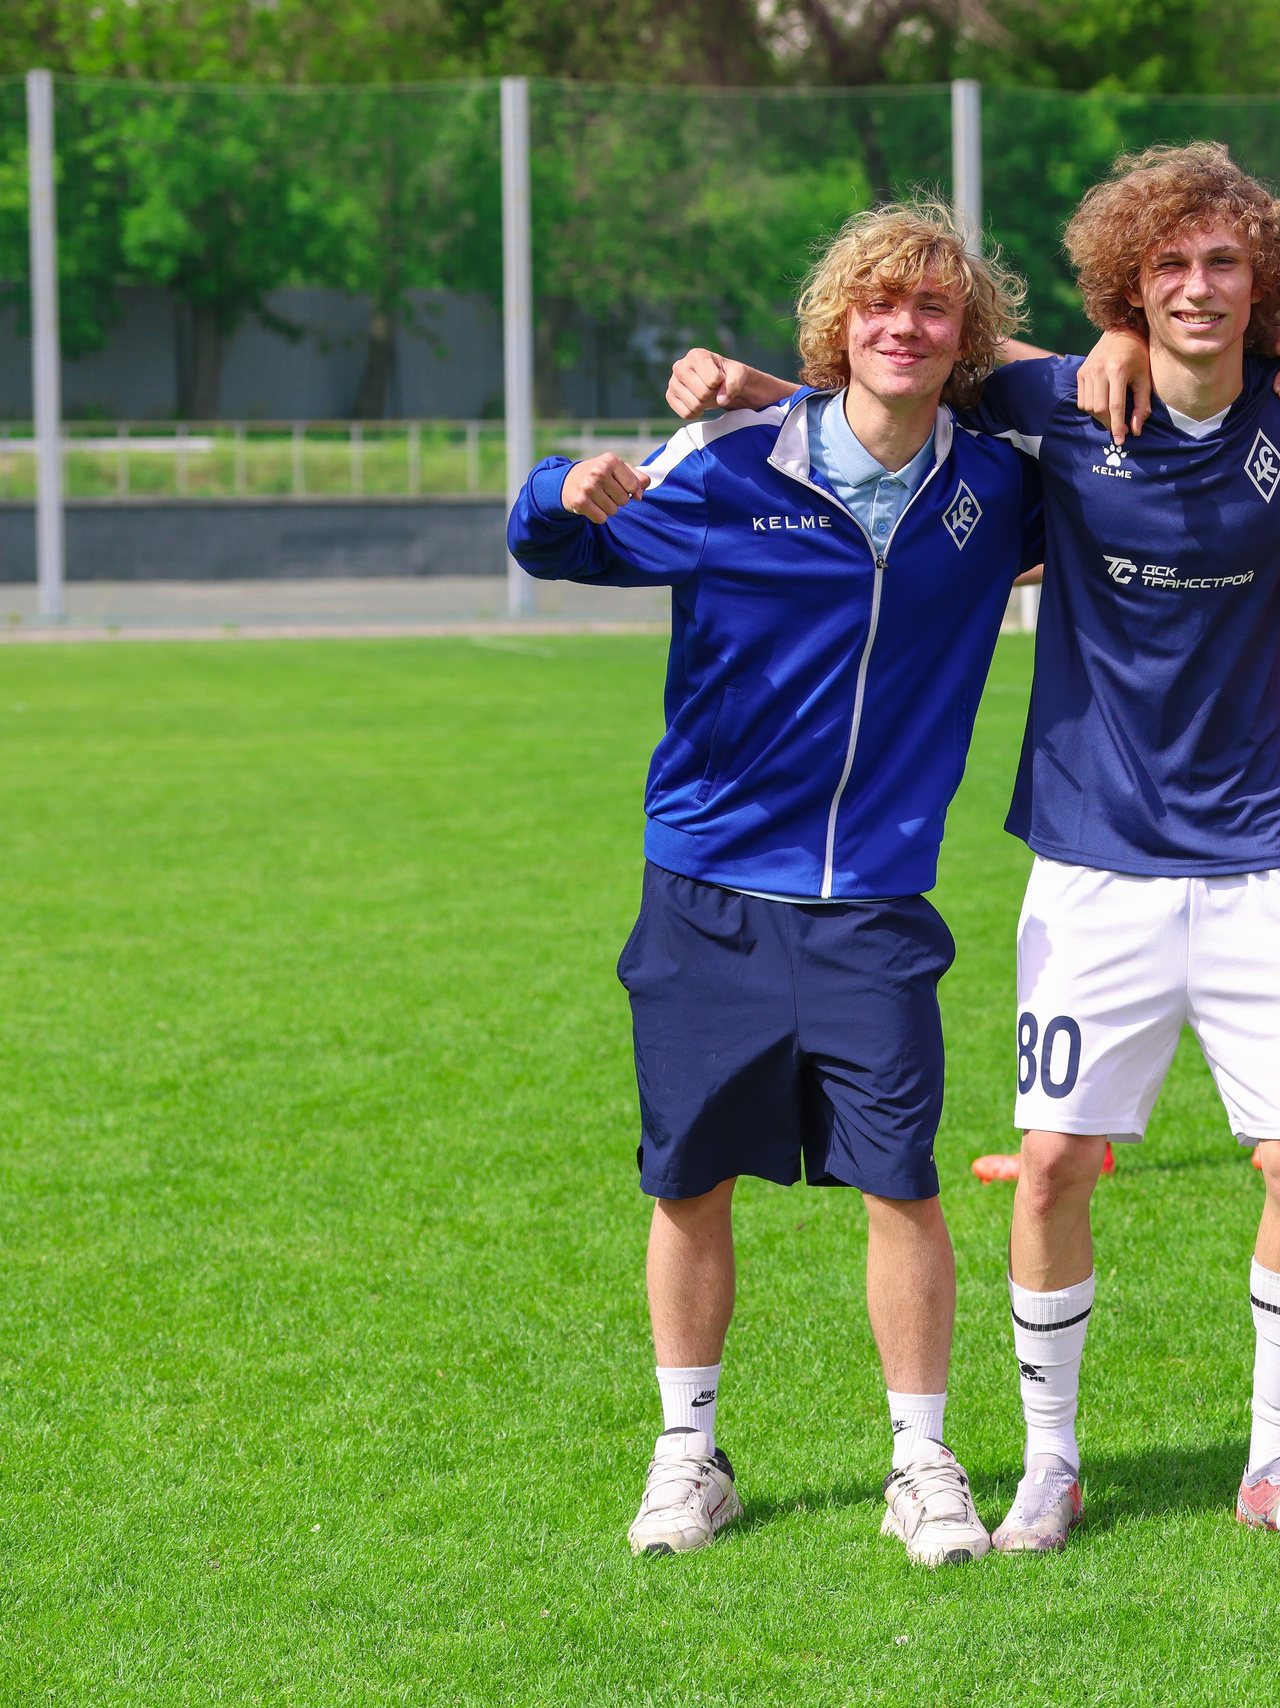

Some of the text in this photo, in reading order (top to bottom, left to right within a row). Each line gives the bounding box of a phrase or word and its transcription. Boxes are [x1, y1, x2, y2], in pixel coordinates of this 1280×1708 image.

[1092, 464, 1132, 479] KELME
[752, 515, 832, 531] KELME
[1141, 564, 1179, 578] ДСК
[1141, 569, 1256, 589] ТРАНССТРОЙ
[1017, 1011, 1082, 1099] 80
